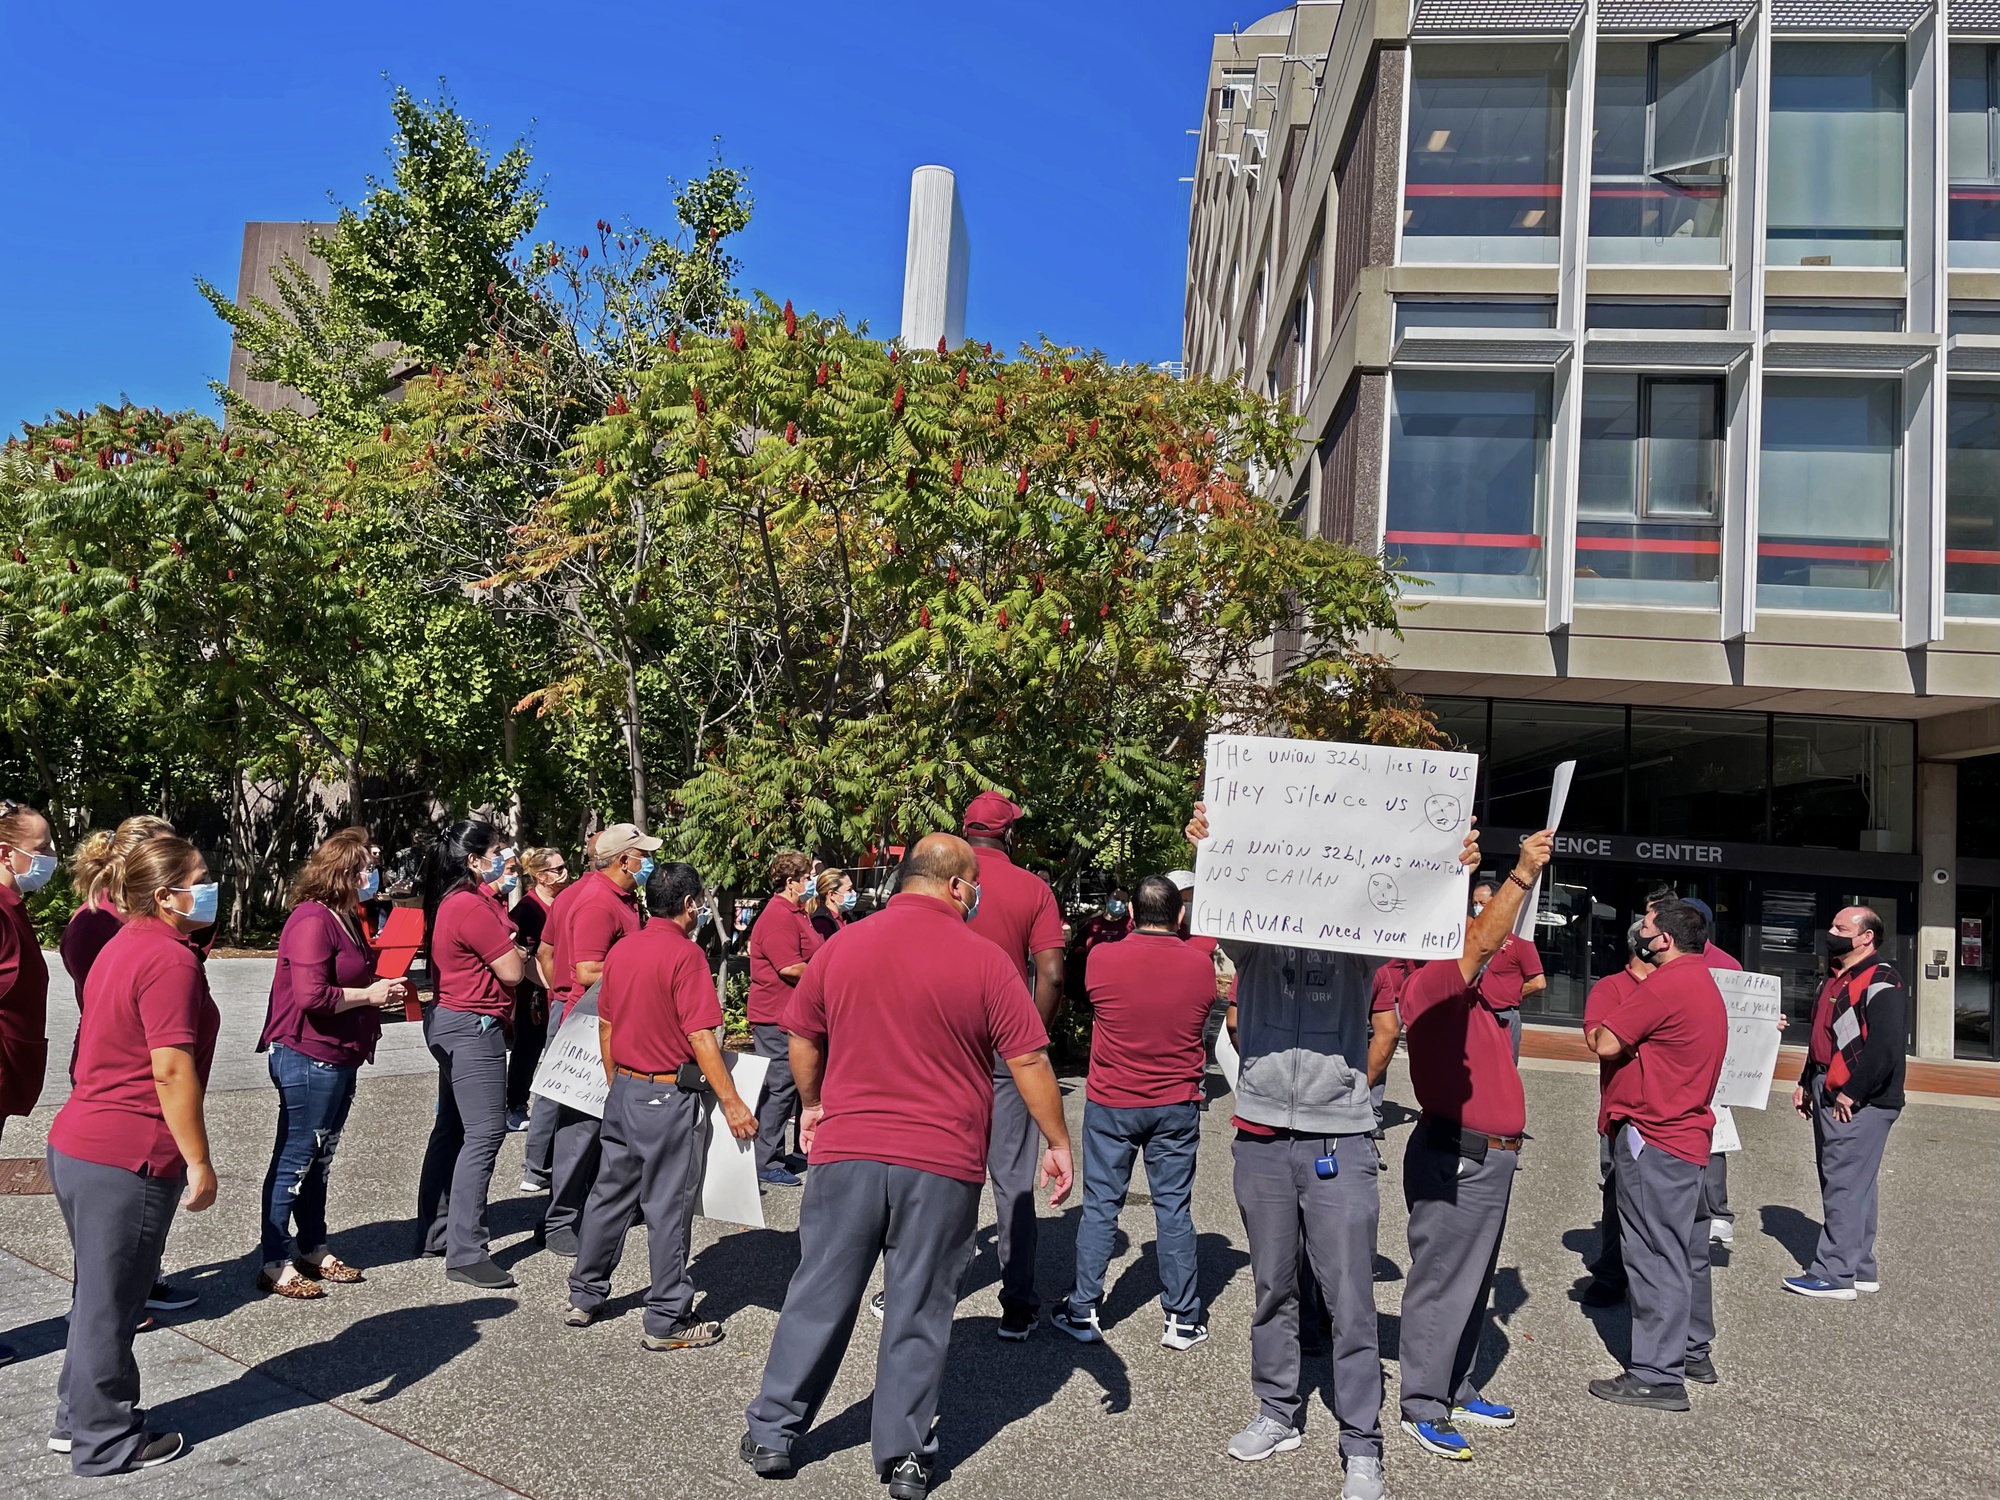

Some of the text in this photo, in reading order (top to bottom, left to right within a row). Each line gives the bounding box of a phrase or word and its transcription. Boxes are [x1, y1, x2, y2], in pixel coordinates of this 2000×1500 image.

[1209, 839, 1234, 855] LA
[1371, 854, 1402, 868] NOS
[1519, 834, 1722, 863] ENCE CENTER
[1206, 866, 1250, 882] NOS
[1319, 924, 1361, 940] Need
[1373, 929, 1407, 943] YOUR
[1305, 991, 1333, 1003] YORK
[543, 1078, 570, 1094] NOS
